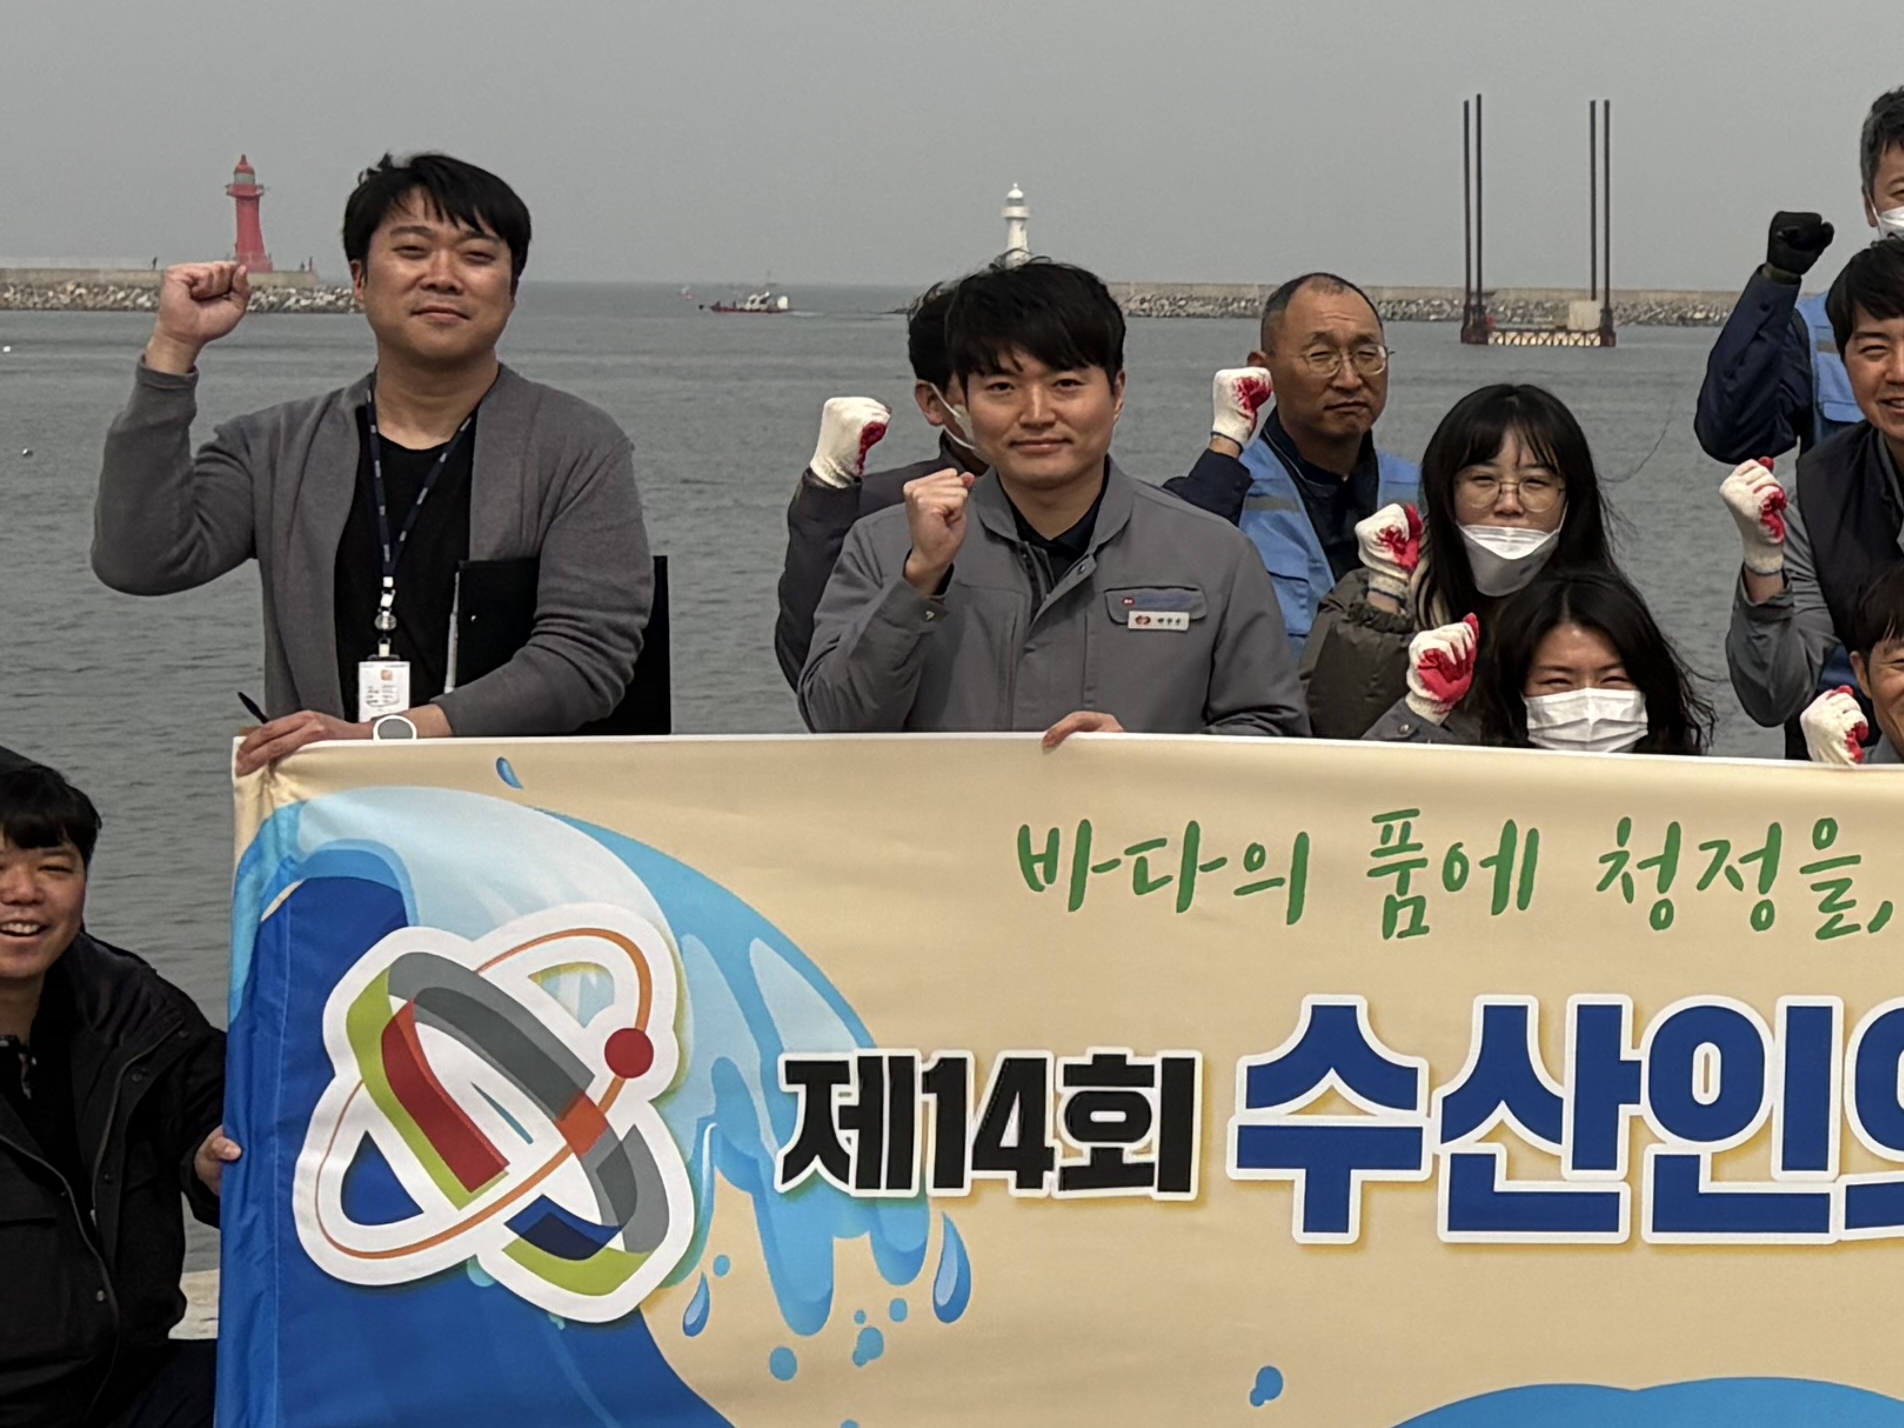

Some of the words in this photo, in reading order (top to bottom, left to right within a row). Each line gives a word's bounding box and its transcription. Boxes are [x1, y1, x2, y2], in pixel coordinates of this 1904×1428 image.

[1018, 820, 1309, 925] 바다의
[1371, 809, 1539, 939] 품에
[1600, 817, 1893, 940] 청정을,
[780, 1052, 1196, 1194] 제14회
